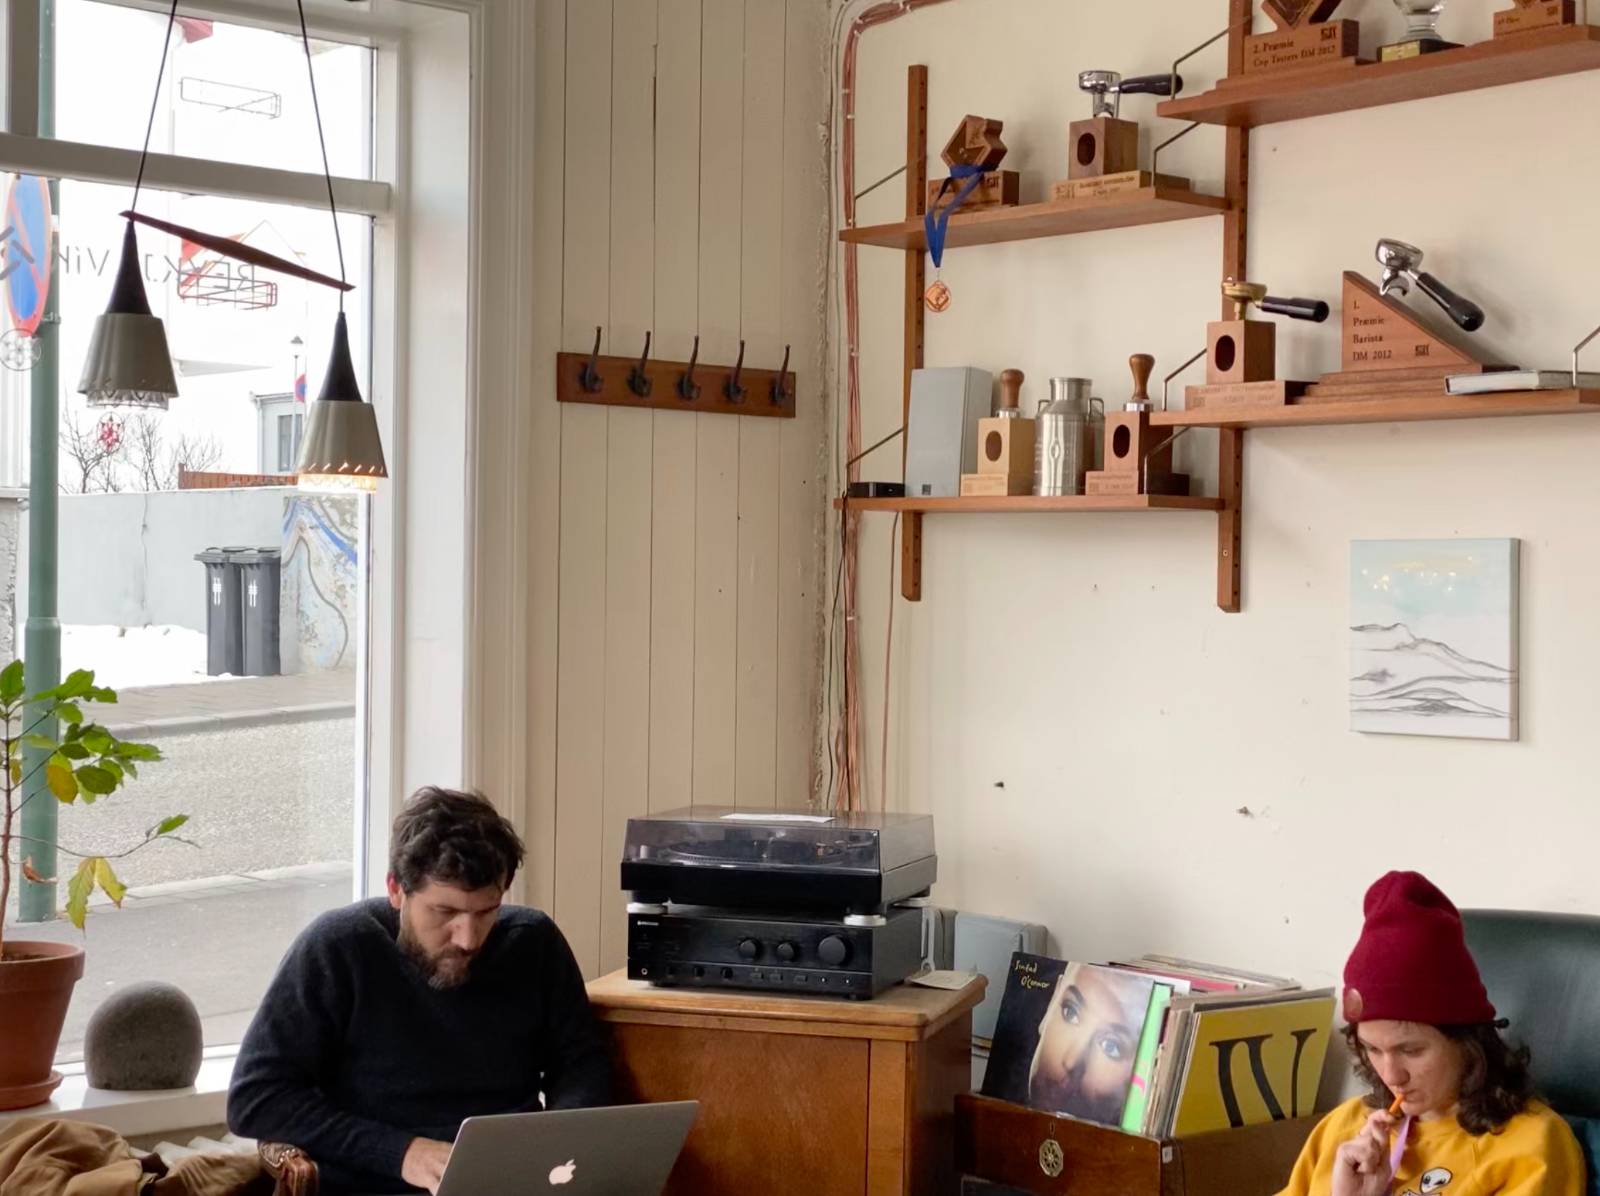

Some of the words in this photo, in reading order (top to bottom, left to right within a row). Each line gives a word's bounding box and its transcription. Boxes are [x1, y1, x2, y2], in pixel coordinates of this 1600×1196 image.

[1353, 316, 1385, 327] Præmie
[1353, 333, 1384, 344] Barista
[1353, 350, 1368, 361] DM
[1372, 350, 1392, 360] 2012
